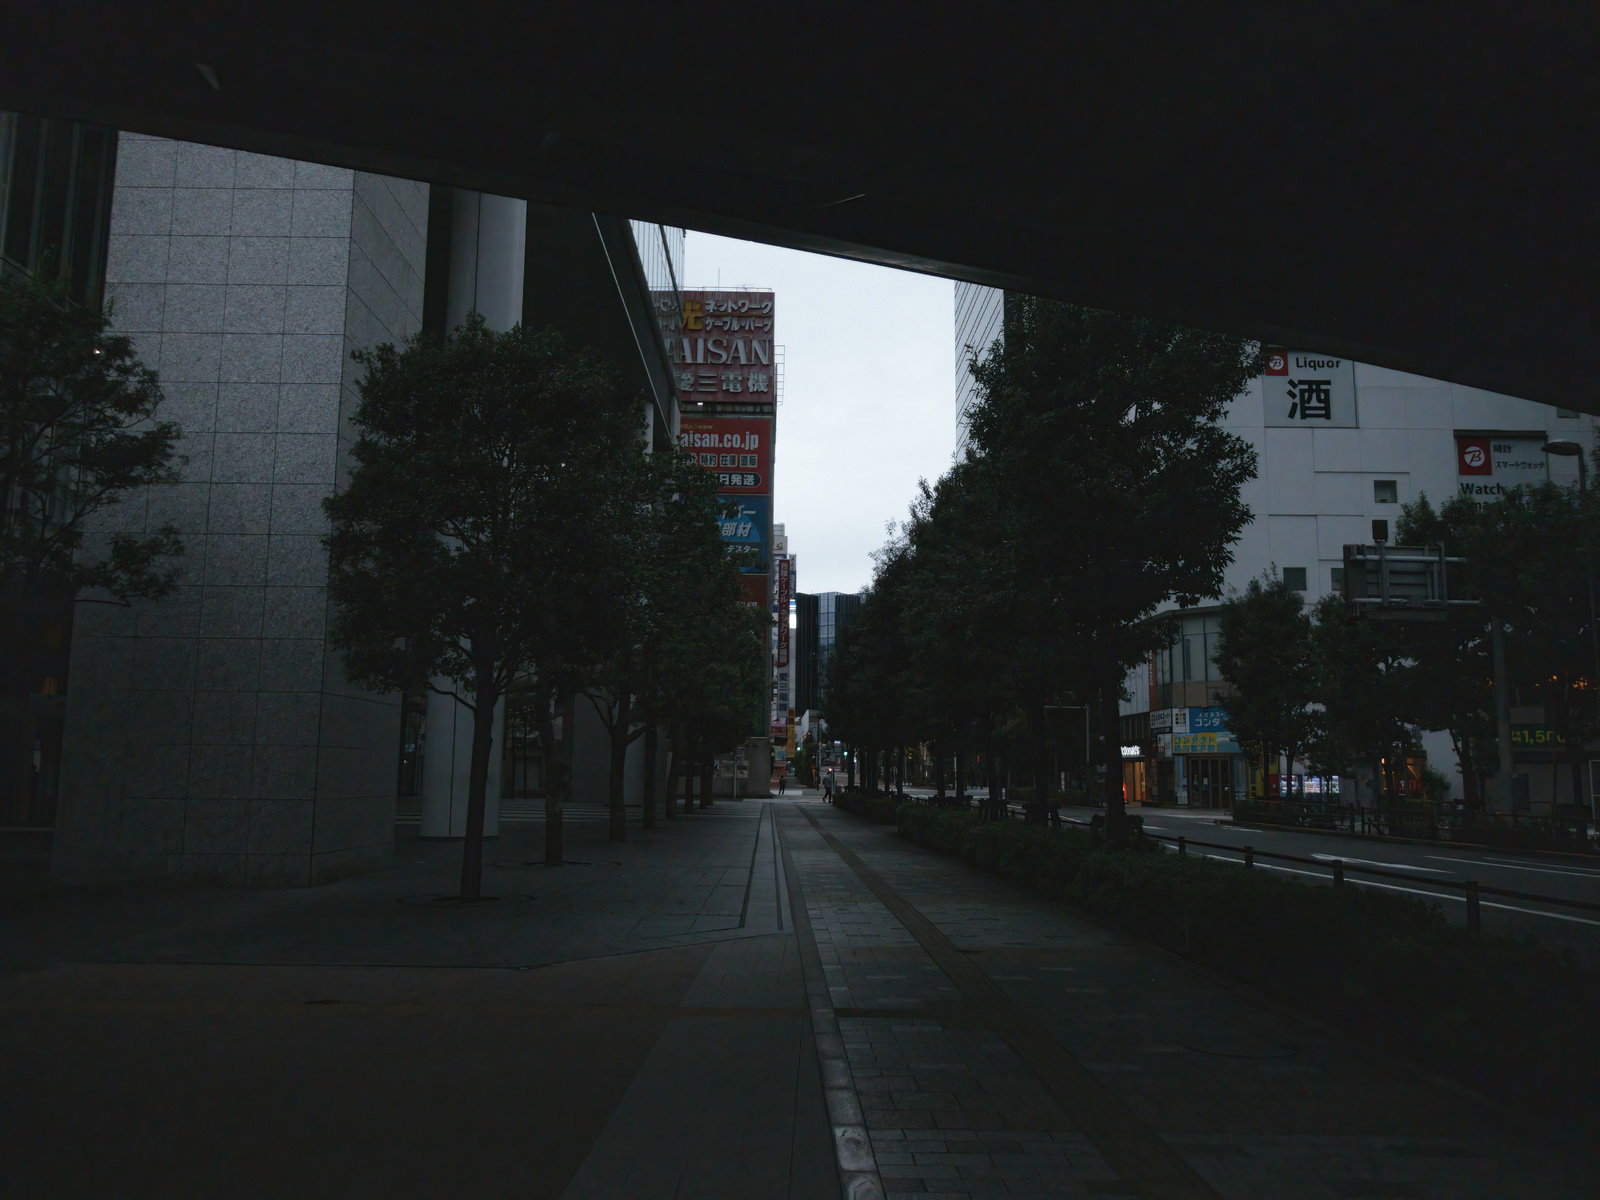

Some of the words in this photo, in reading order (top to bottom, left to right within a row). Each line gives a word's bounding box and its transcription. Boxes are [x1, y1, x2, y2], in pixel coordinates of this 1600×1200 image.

[705, 298, 773, 314] ネットワーク
[683, 300, 704, 331] 光
[1296, 356, 1341, 371] Liquor
[1286, 378, 1331, 420] 酒
[681, 431, 759, 450] aisan.co.jp
[1460, 482, 1505, 496] Watch
